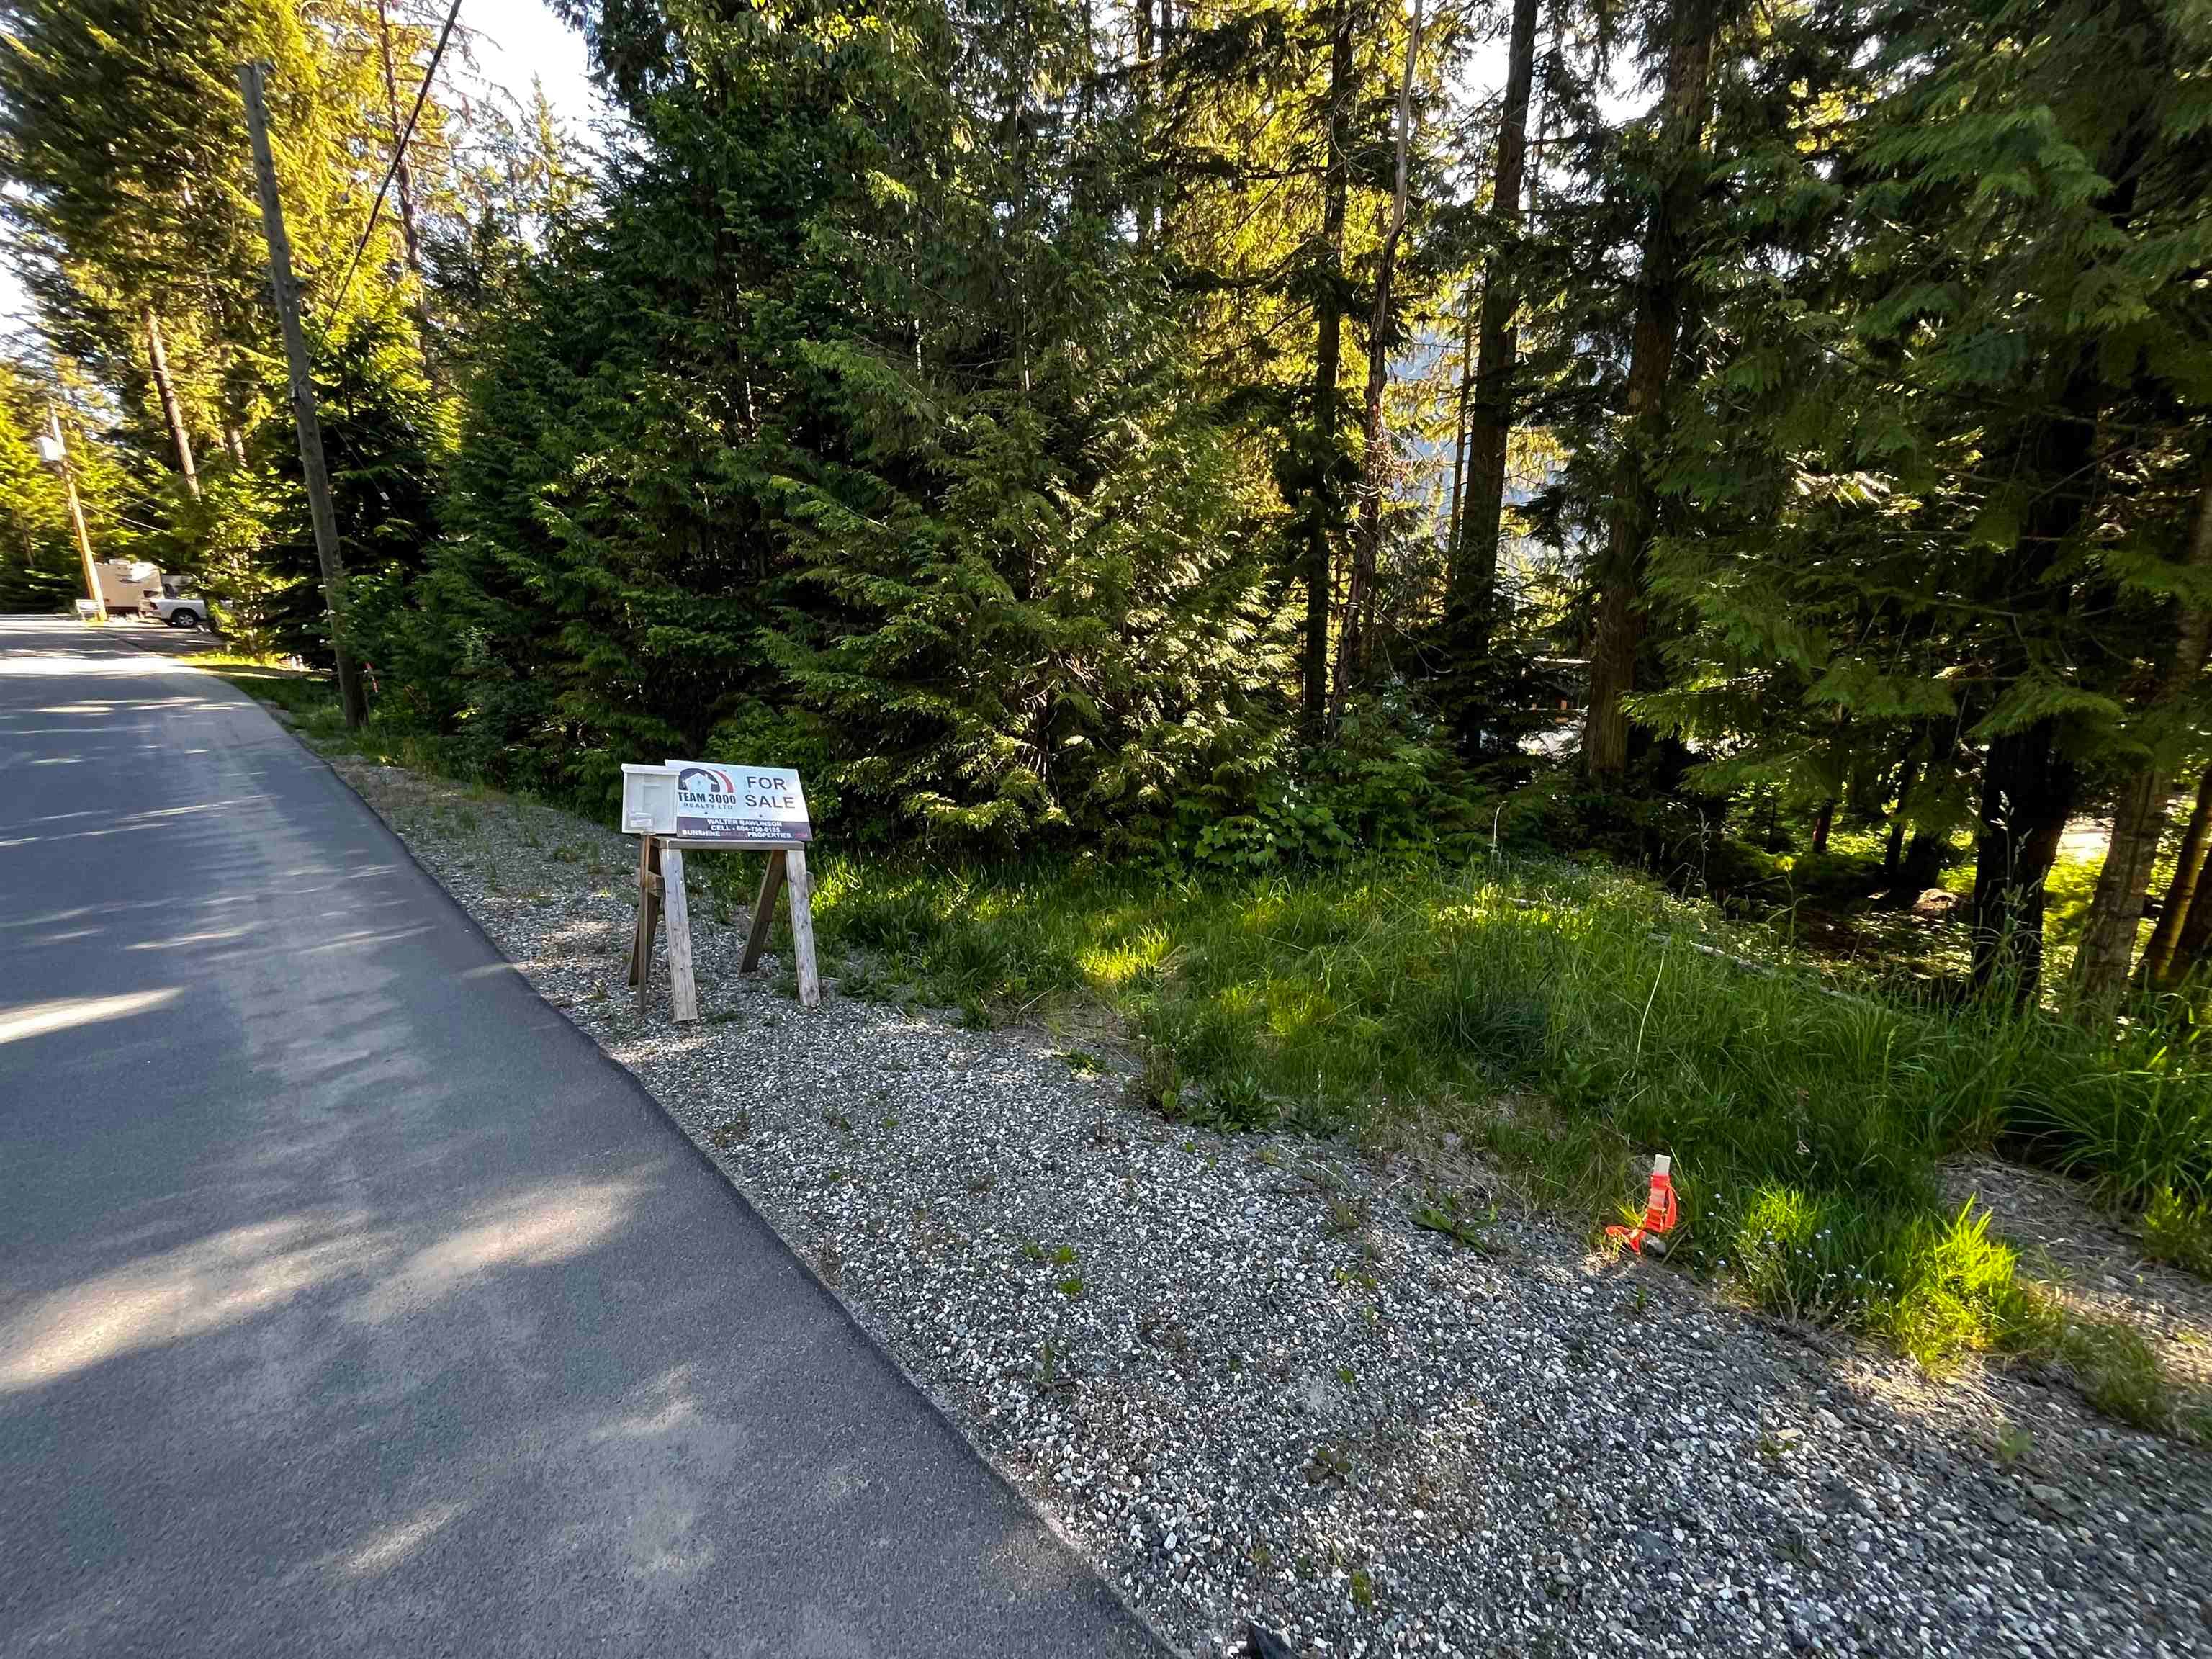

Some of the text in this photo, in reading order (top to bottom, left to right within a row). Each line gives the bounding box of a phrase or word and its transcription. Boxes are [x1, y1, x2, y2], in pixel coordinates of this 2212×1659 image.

[746, 776, 787, 791] FOR
[678, 791, 737, 804] TEAM 3000
[745, 794, 796, 809] SALE
